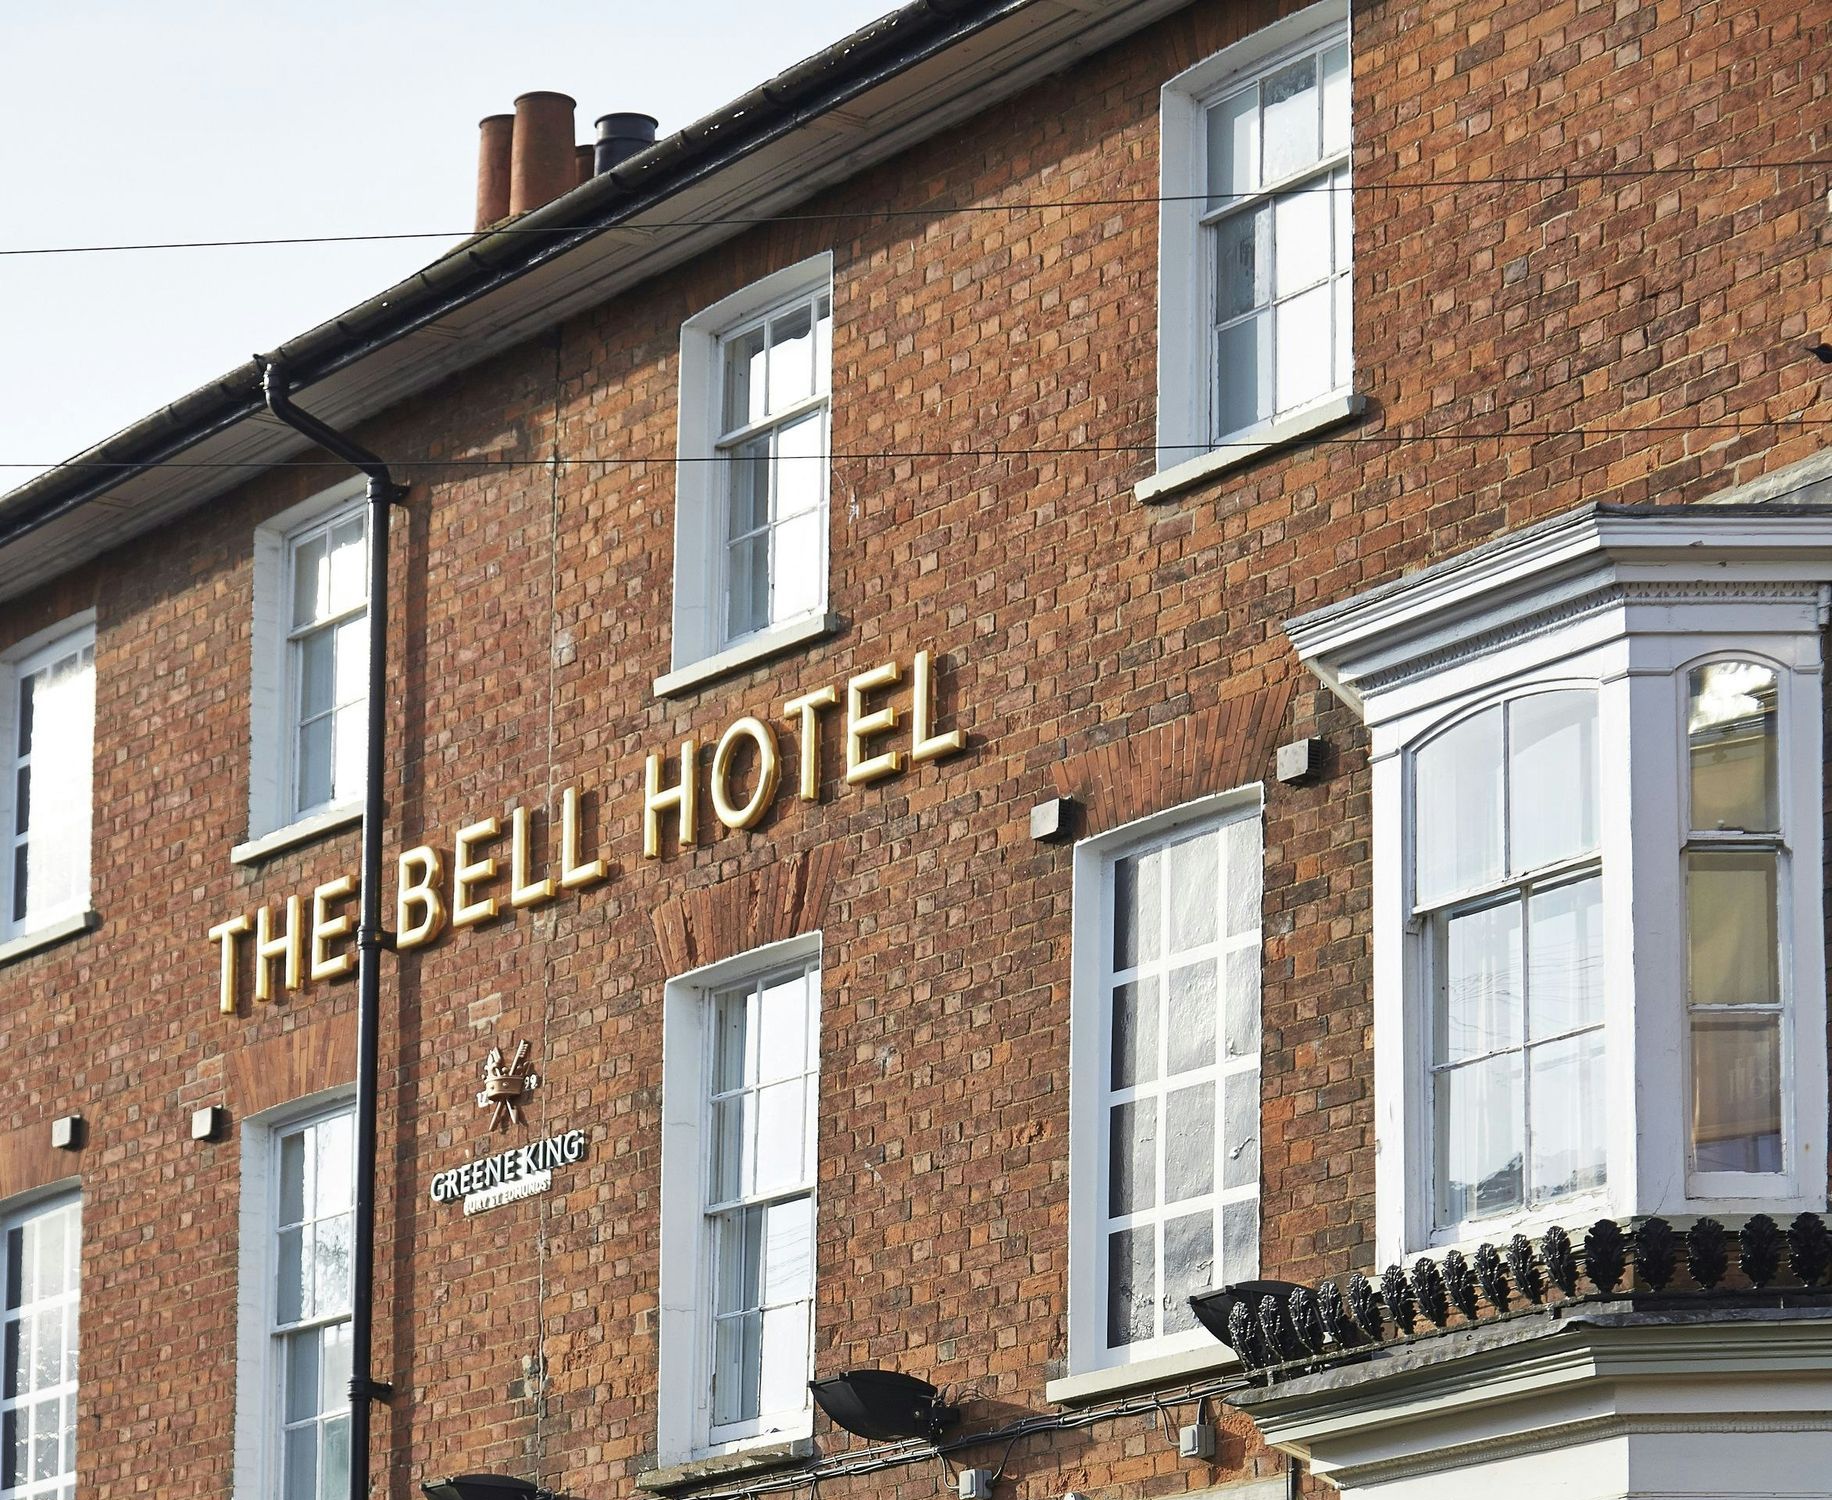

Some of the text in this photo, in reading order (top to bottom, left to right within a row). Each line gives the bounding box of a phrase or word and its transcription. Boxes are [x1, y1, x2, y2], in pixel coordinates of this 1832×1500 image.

[208, 649, 967, 1016] THE BELL HOTEL
[430, 1129, 586, 1202] GREENE KING
[504, 1179, 551, 1201] EDMUNDS
